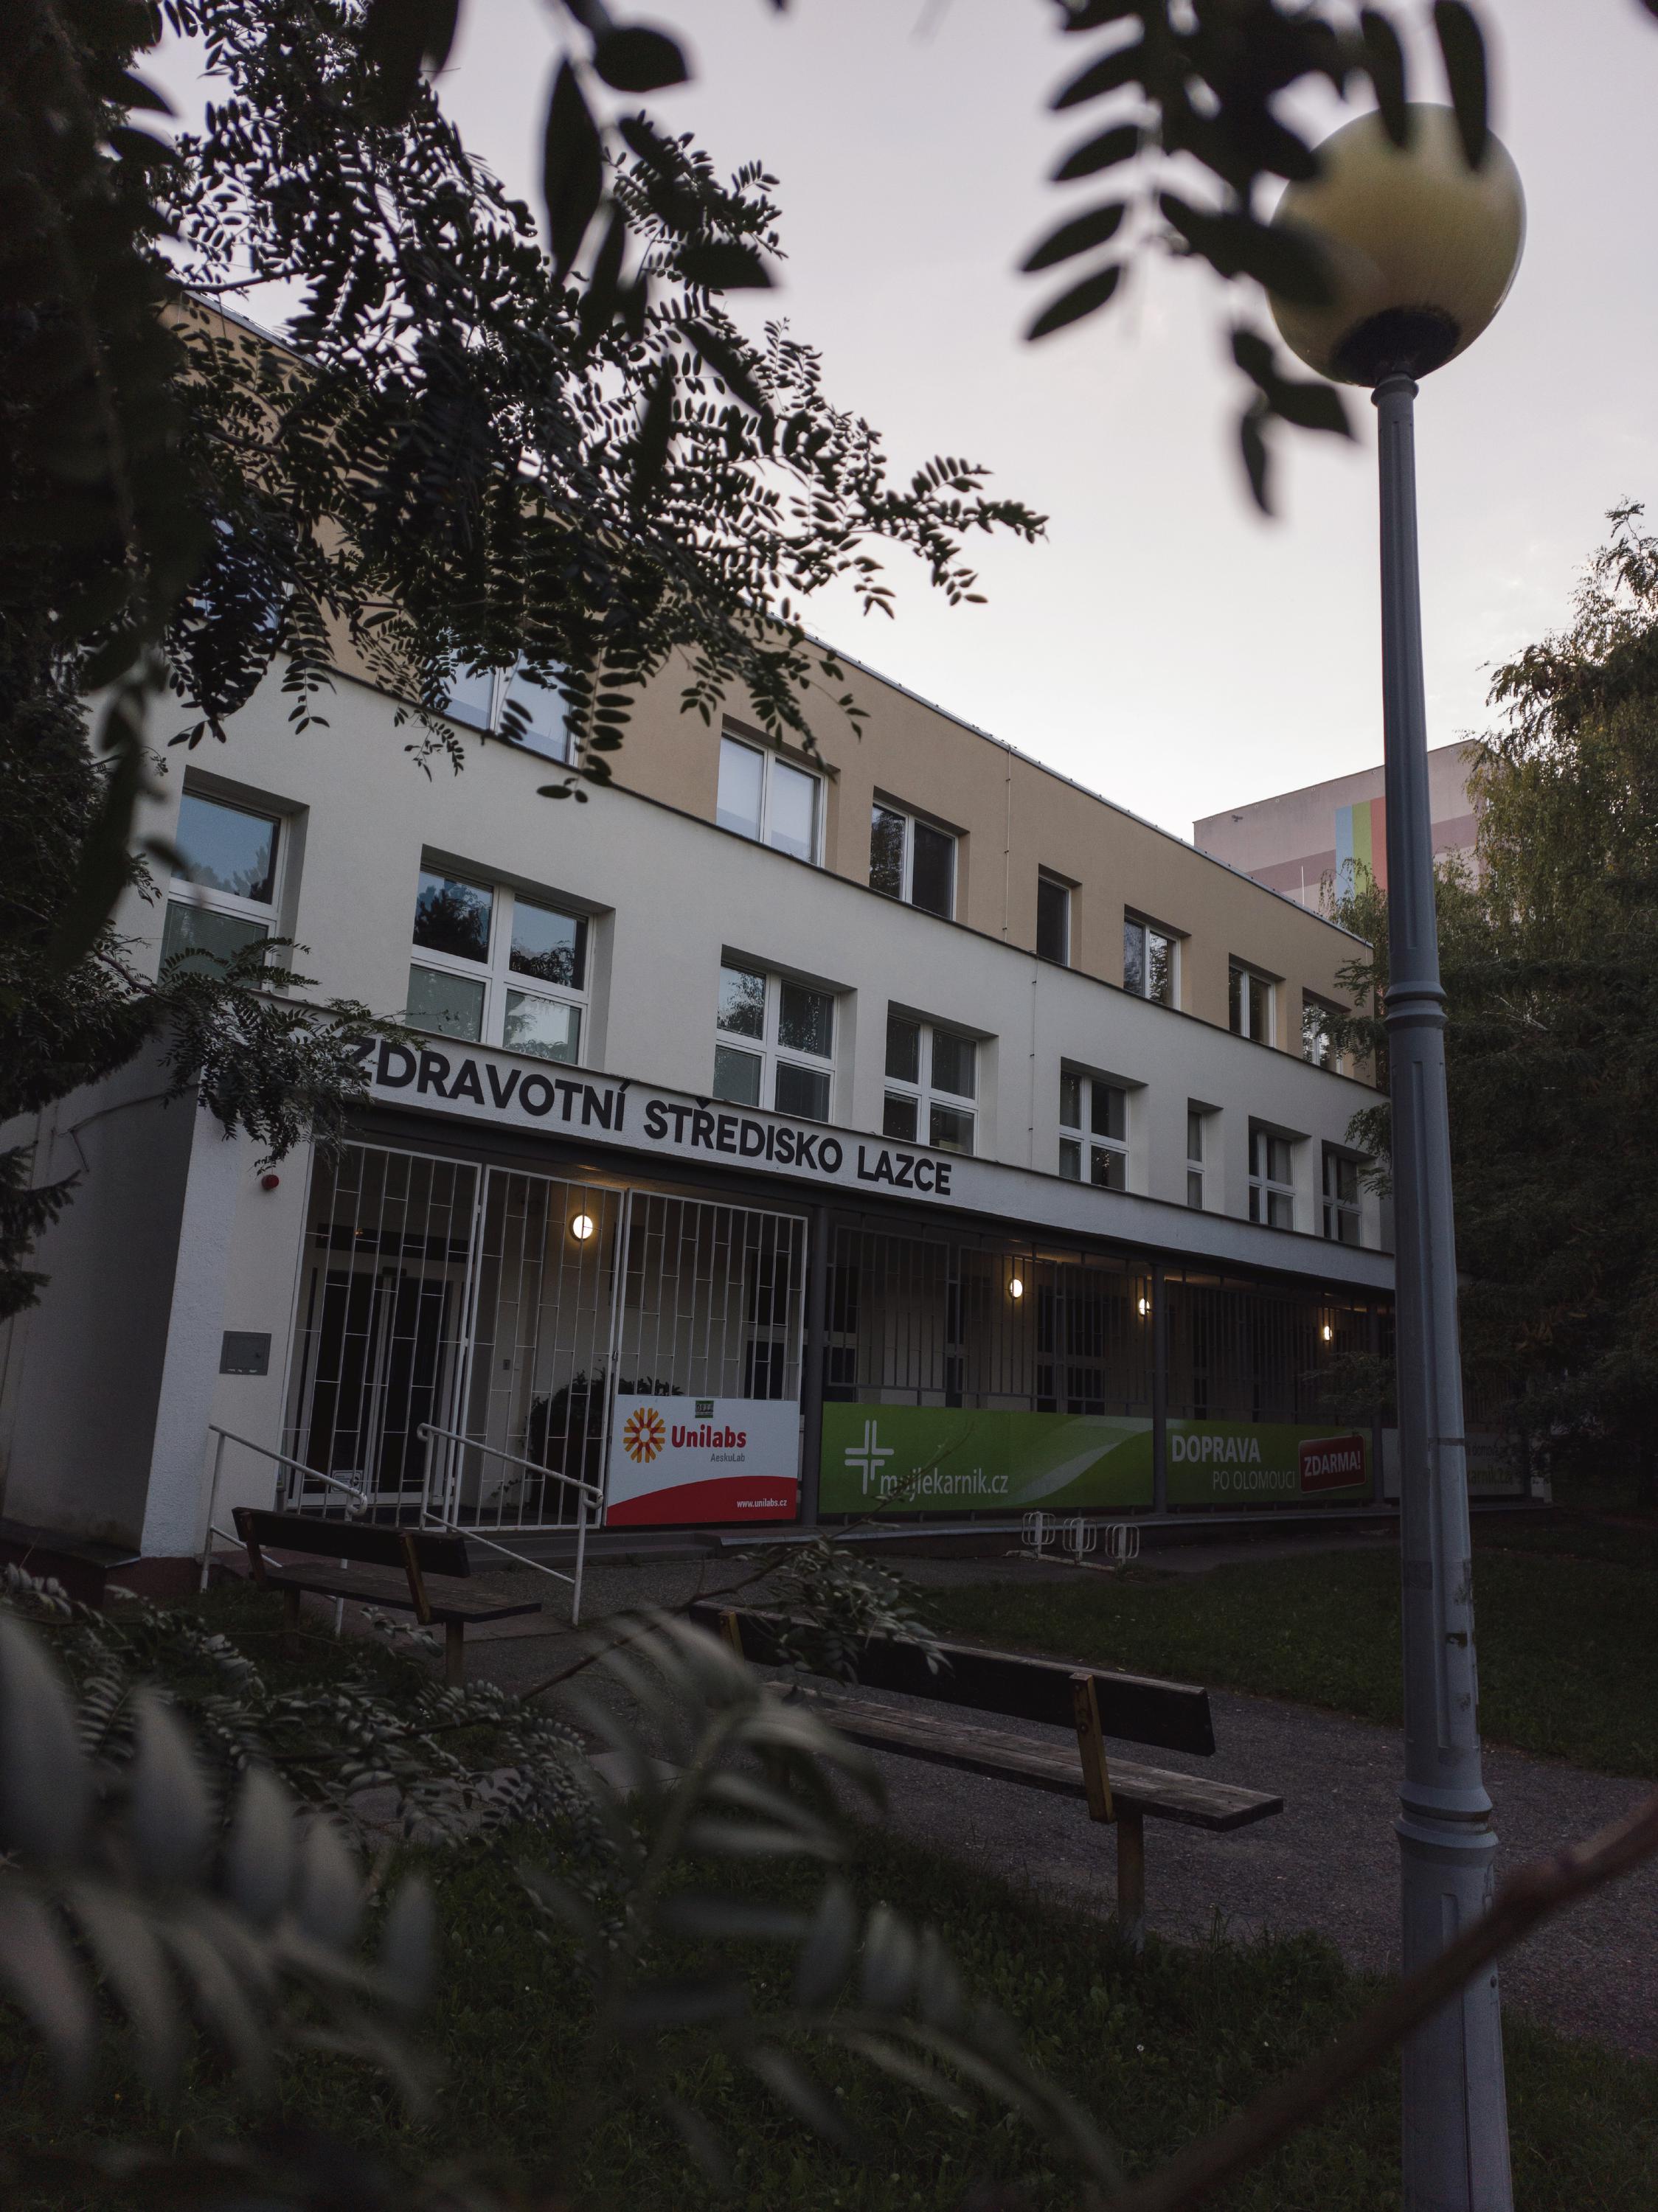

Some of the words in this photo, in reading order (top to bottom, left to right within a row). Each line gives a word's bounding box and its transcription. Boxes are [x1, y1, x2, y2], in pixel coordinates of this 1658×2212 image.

[643, 1096, 843, 1174] STŘEDISKO
[857, 1145, 952, 1196] LAZCE
[671, 1424, 746, 1448] Unilabs
[710, 1453, 745, 1463] AeskuLab
[1171, 1435, 1262, 1464] DOPRAVA
[1303, 1450, 1362, 1478] ZDARMA!
[880, 1467, 1009, 1502] mjlekarnik.cz
[1213, 1471, 1230, 1490] PO
[1233, 1470, 1296, 1489] OLOMOUCI
[737, 1498, 788, 1509] www.unilabs.cz
